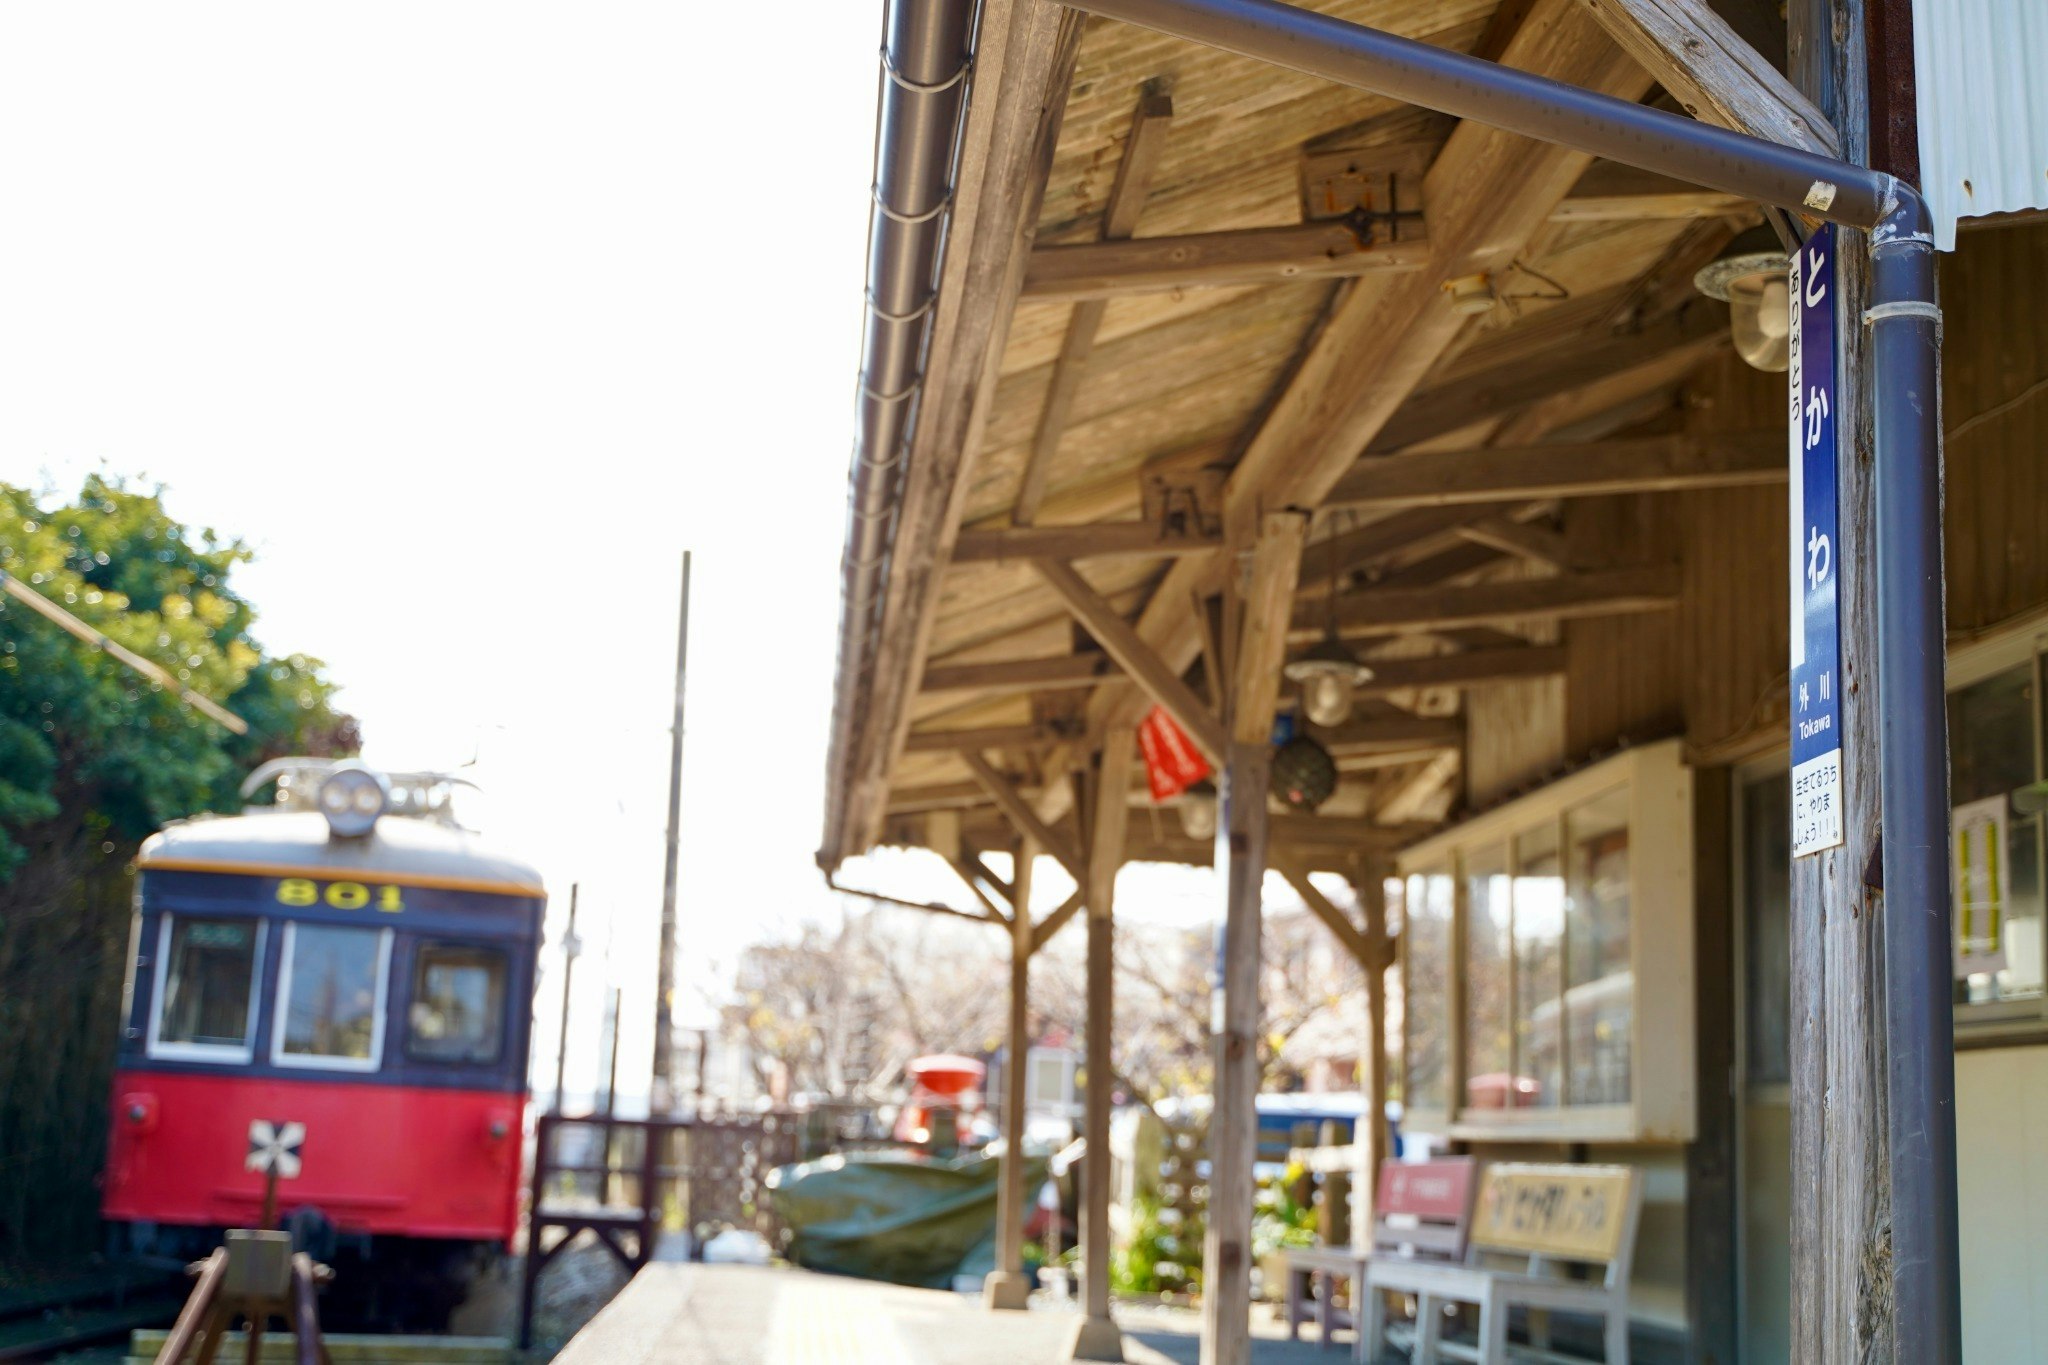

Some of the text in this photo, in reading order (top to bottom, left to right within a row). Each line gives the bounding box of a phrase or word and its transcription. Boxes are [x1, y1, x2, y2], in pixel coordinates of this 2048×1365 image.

[1791, 269, 1800, 421] ありがとう
[1805, 247, 1830, 591] とかわ
[1799, 714, 1831, 740] Tokawa
[1796, 765, 1837, 796] 生きてるうち
[275, 878, 406, 914] 801
